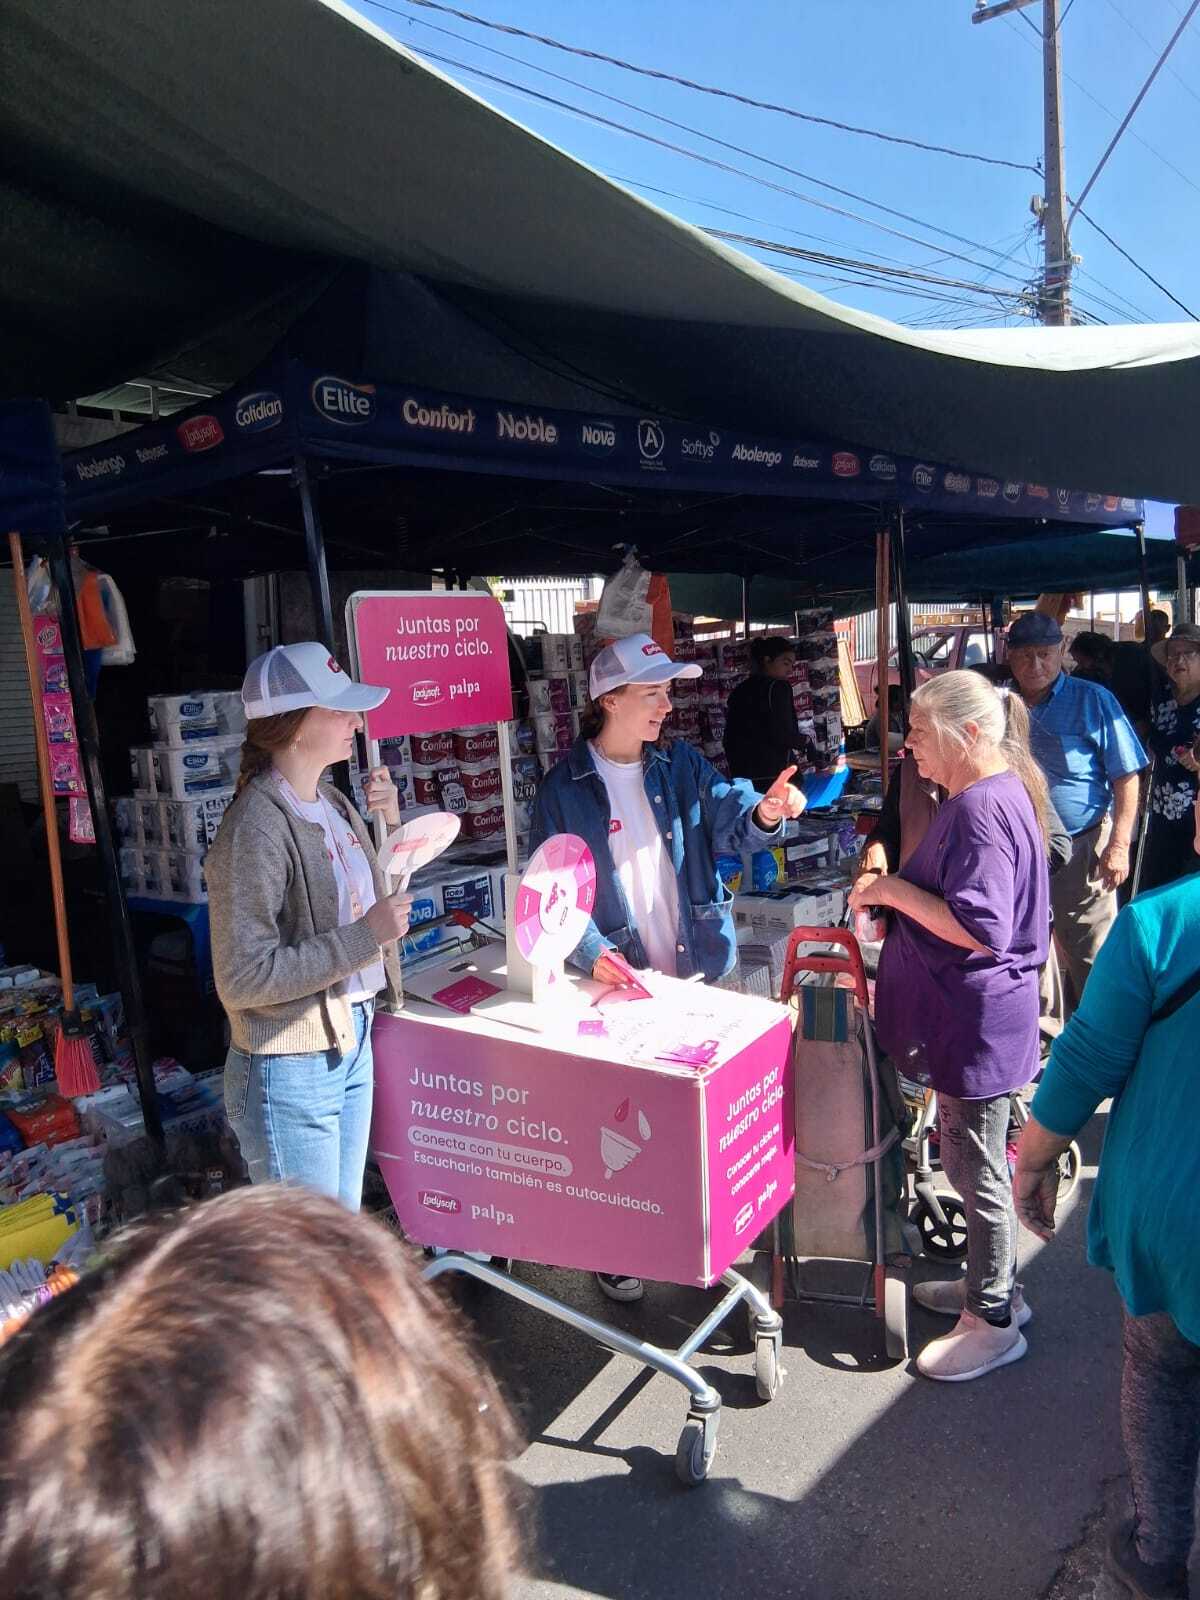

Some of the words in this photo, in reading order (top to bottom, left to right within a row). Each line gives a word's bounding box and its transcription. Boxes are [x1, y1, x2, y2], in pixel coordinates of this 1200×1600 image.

[233, 398, 282, 428] Cotidian
[321, 385, 369, 417] Elite
[400, 399, 475, 433] Confort
[495, 411, 558, 445] Noble
[580, 424, 614, 448] Nova
[681, 438, 714, 460] Softys
[731, 443, 782, 468] Abolengo
[396, 616, 451, 635] Juntas
[455, 617, 480, 638] por
[386, 641, 450, 662] nuestro
[455, 637, 493, 657] ciclo.
[449, 678, 481, 700] palpa
[420, 738, 453, 752] Confort
[465, 736, 498, 751] Confort
[472, 774, 501, 789] Confort
[408, 1067, 484, 1097] Juntas
[490, 1083, 530, 1106] por
[726, 1083, 761, 1121] Juntas
[763, 1066, 780, 1092] por
[410, 1099, 499, 1130] nuestro
[506, 1115, 569, 1145] ciclo.
[719, 1106, 760, 1153] nuestro
[412, 1129, 467, 1152] Conecta
[469, 1143, 494, 1158] con
[496, 1146, 511, 1162] tu
[514, 1153, 568, 1173] cuerpo.
[413, 1151, 482, 1177] Escucharlo
[485, 1165, 544, 1190] también
[546, 1179, 562, 1194] es
[565, 1184, 665, 1216] autocuidado.
[757, 1179, 778, 1211] palpa
[422, 1192, 458, 1212] Ladysoft
[471, 1203, 515, 1226] palpa
